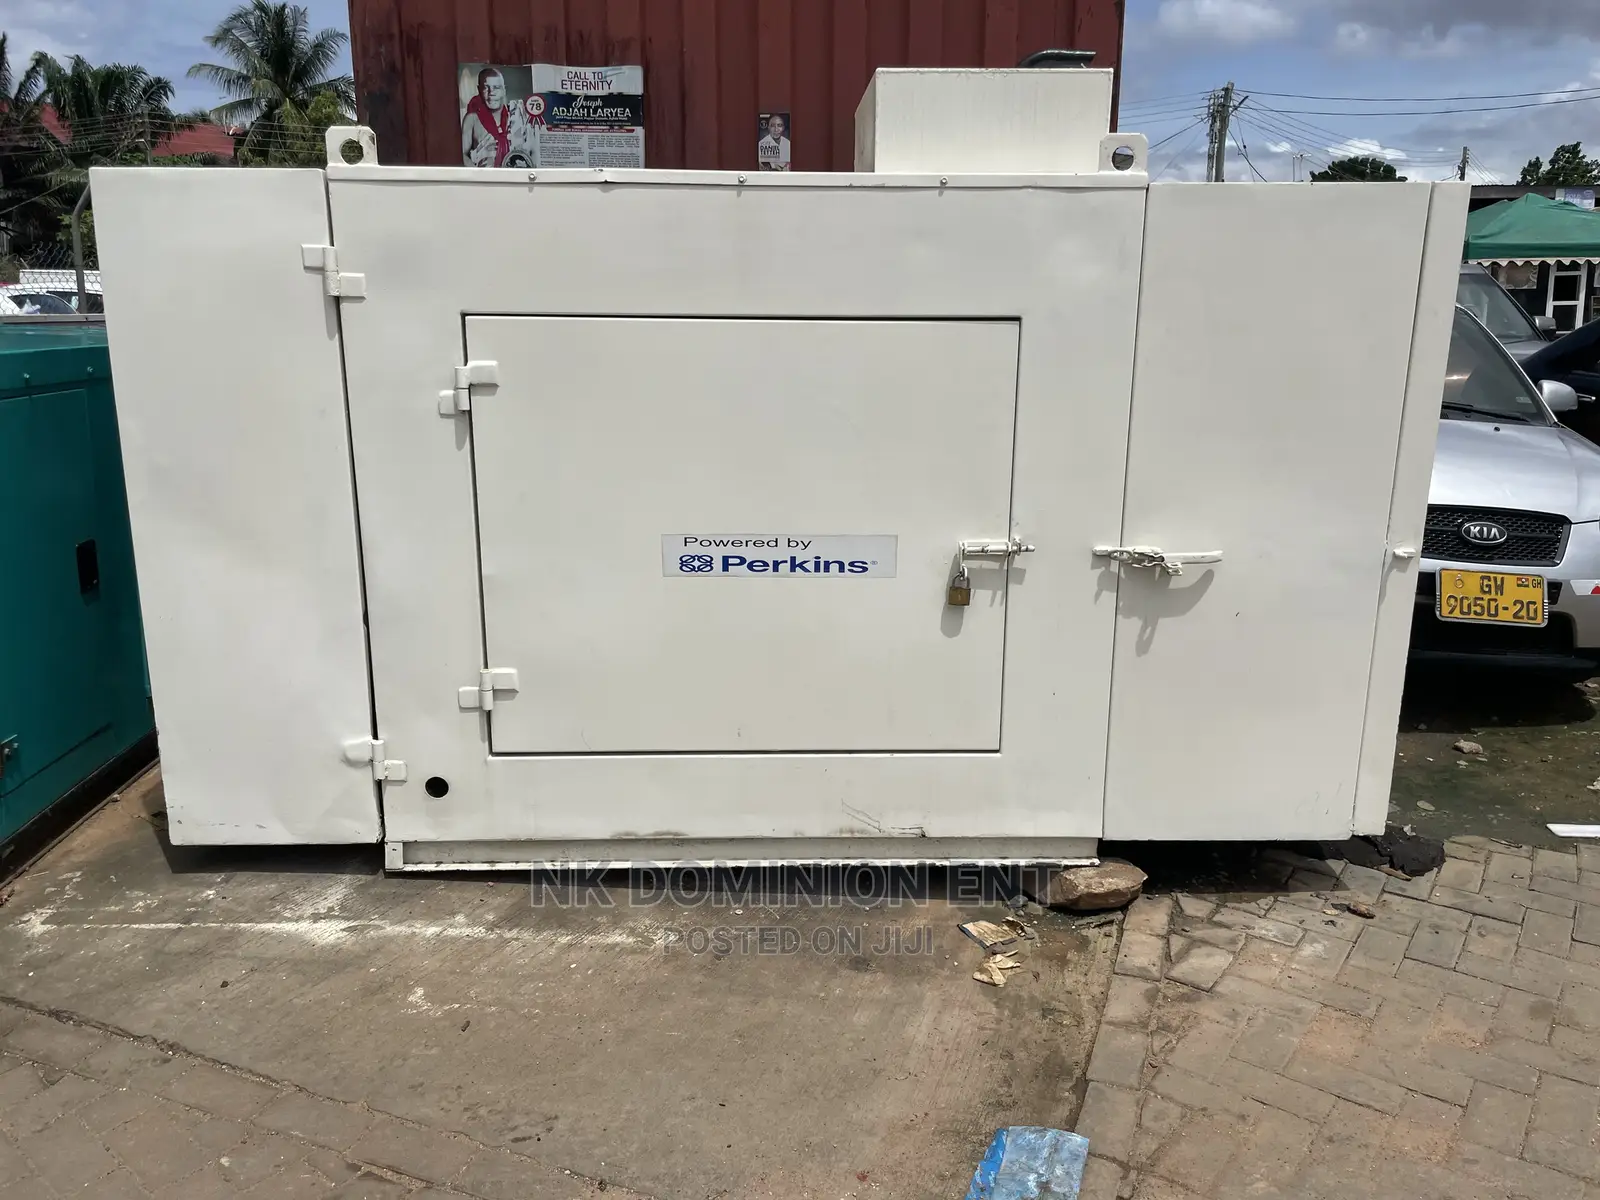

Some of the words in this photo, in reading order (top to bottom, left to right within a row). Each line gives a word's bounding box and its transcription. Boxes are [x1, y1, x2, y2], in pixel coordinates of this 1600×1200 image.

[567, 71, 589, 80] CALL
[592, 71, 603, 80] TO
[561, 80, 613, 91] ETERNITY
[529, 103, 542, 111] 78
[572, 94, 603, 109] Joseph
[552, 107, 587, 117] ADJAH
[590, 108, 631, 118] LARYEA
[1469, 525, 1501, 540] KIA
[683, 536, 778, 548] Powered
[787, 537, 813, 551] by
[1479, 575, 1505, 596] GW
[1531, 578, 1542, 589] GH
[1446, 594, 1538, 621] 9050-20
